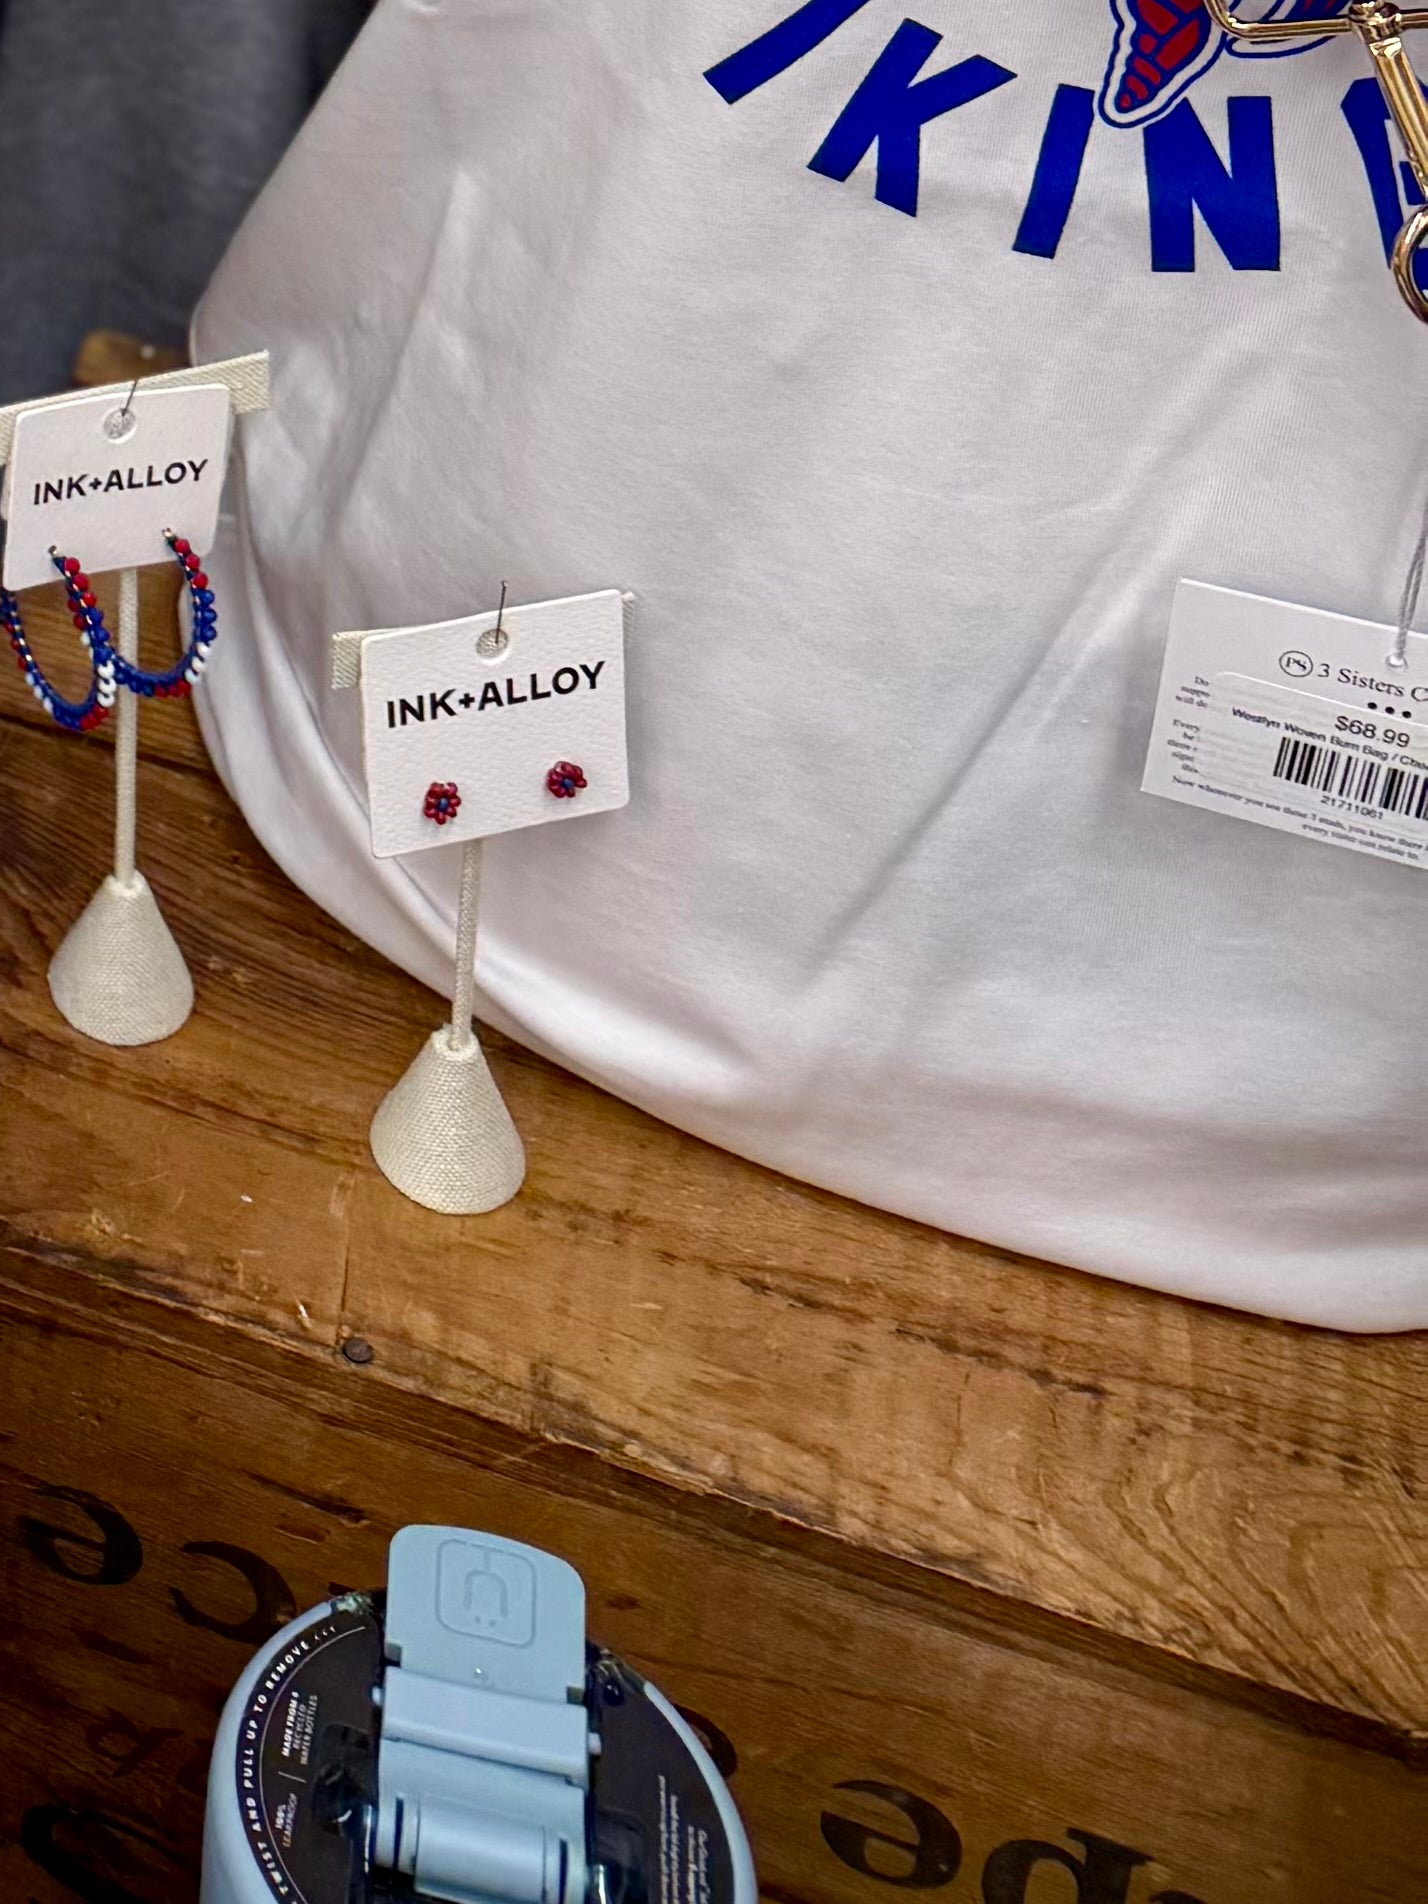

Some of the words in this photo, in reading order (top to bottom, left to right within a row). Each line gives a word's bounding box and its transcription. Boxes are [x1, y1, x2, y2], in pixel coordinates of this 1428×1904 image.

[33, 458, 209, 506] INK+ALLOY
[386, 661, 607, 729] INK+ALLOY
[1318, 663, 1330, 678] 3
[1337, 668, 1404, 697] Sisters
[1284, 721, 1326, 742] Woven
[1330, 735, 1359, 751] Bum
[1363, 745, 1389, 762] Bag
[1335, 715, 1411, 748] $68.99
[265, 1640, 310, 1690] REMOVE
[253, 1694, 268, 1713] TO
[246, 1719, 258, 1740] UP
[243, 1748, 255, 1789] PULL
[246, 1796, 262, 1832] AND
[257, 1841, 289, 1895] TWIST
